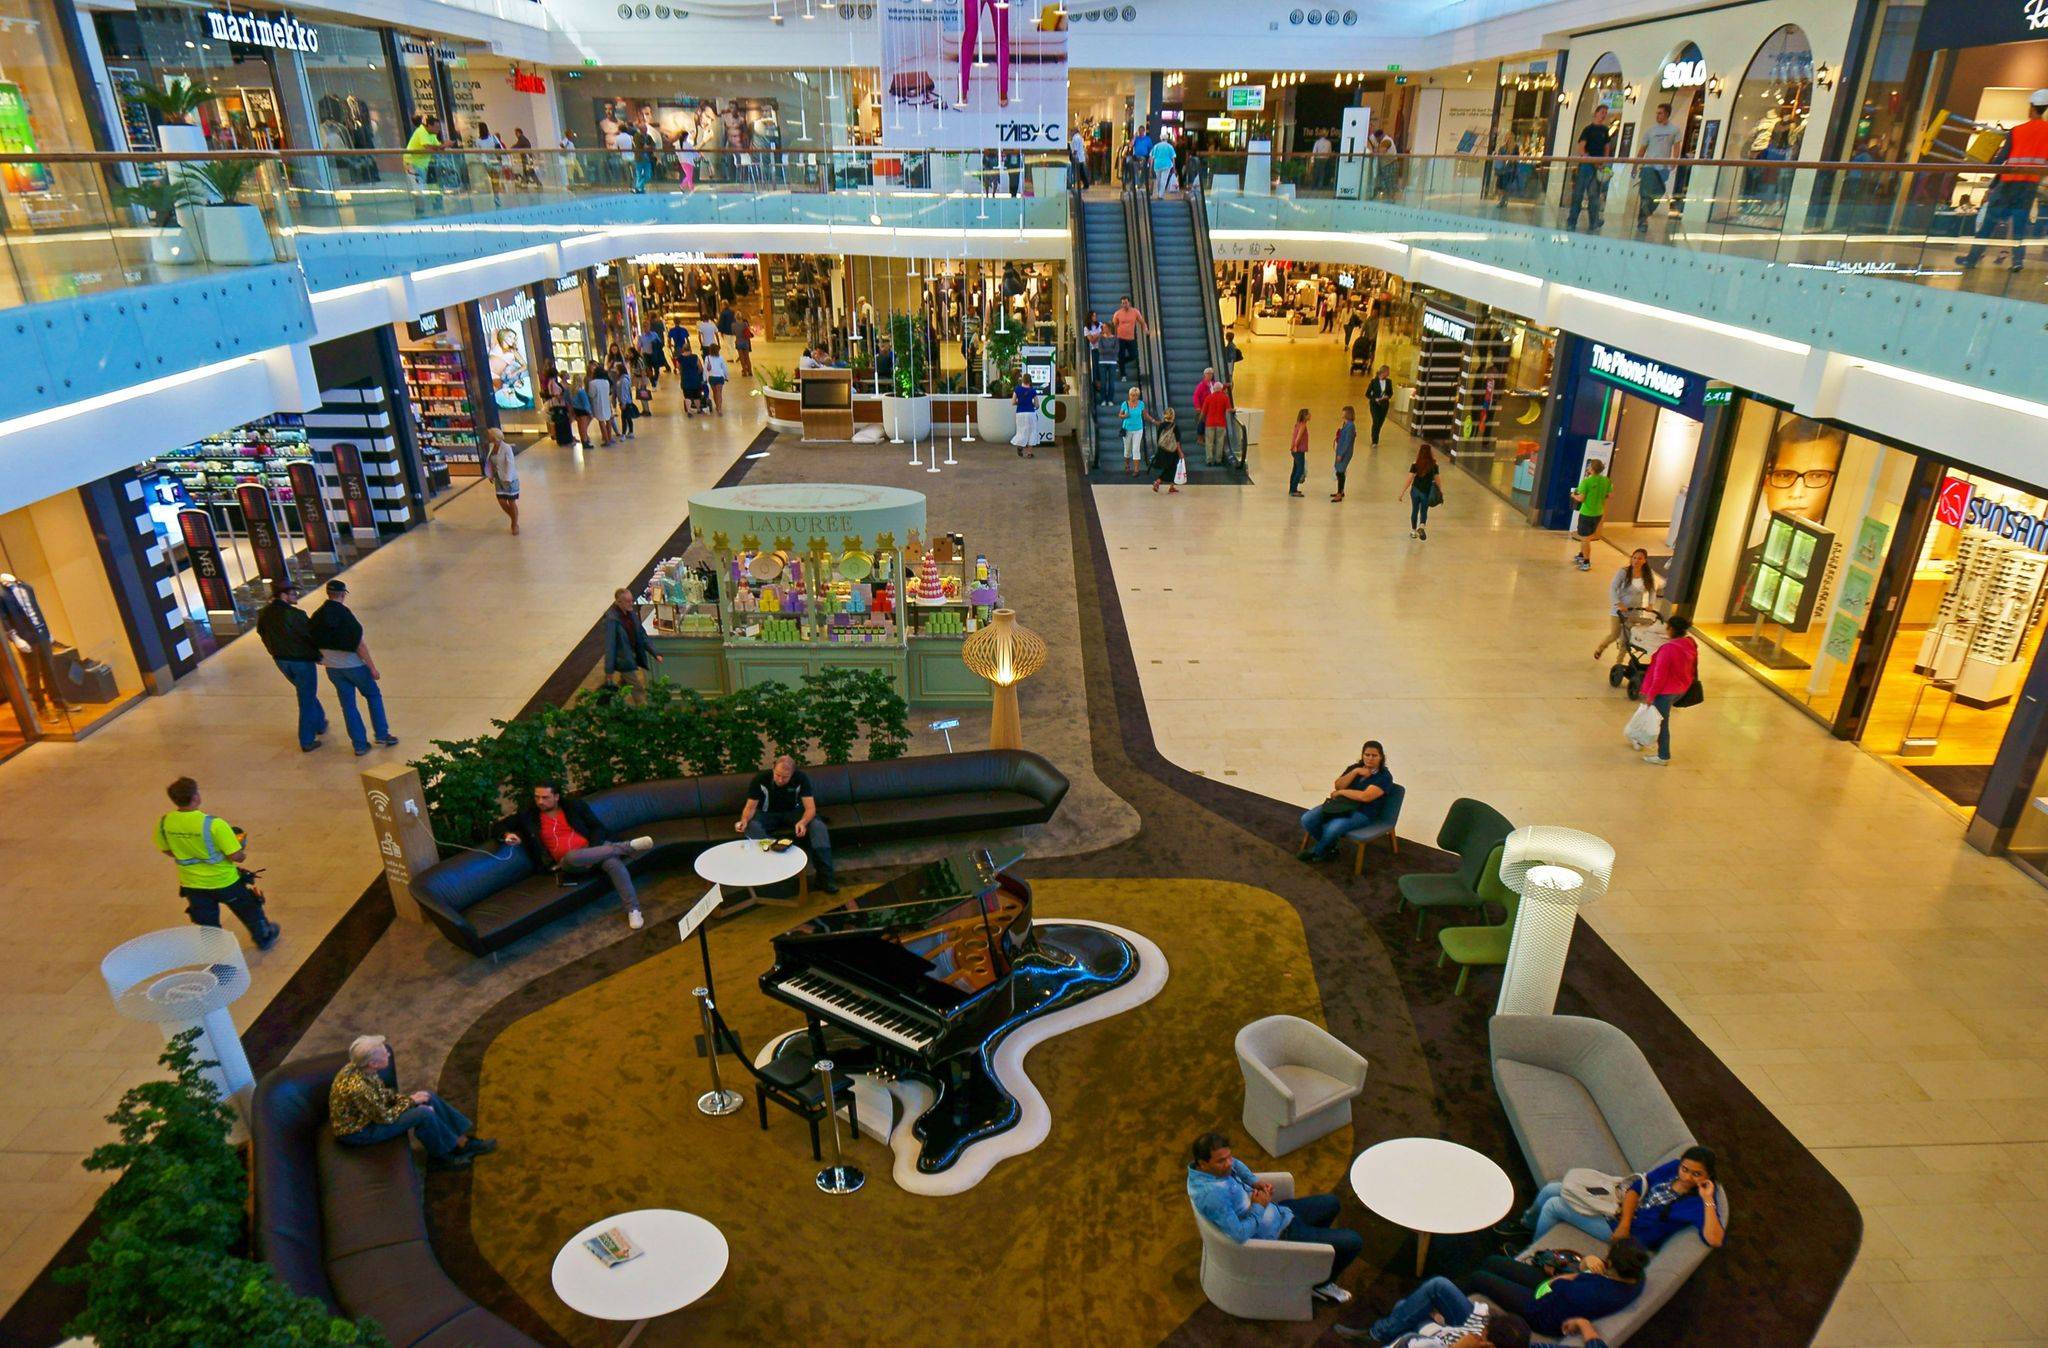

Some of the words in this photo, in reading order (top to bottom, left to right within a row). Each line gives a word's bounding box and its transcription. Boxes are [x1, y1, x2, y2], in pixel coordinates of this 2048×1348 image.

[207, 11, 318, 53] marimekko
[1661, 60, 1707, 88] SOLO
[478, 290, 536, 334] hunkemöller
[1592, 344, 1613, 373] The
[1610, 350, 1647, 385] Phone
[1643, 362, 1685, 399] House
